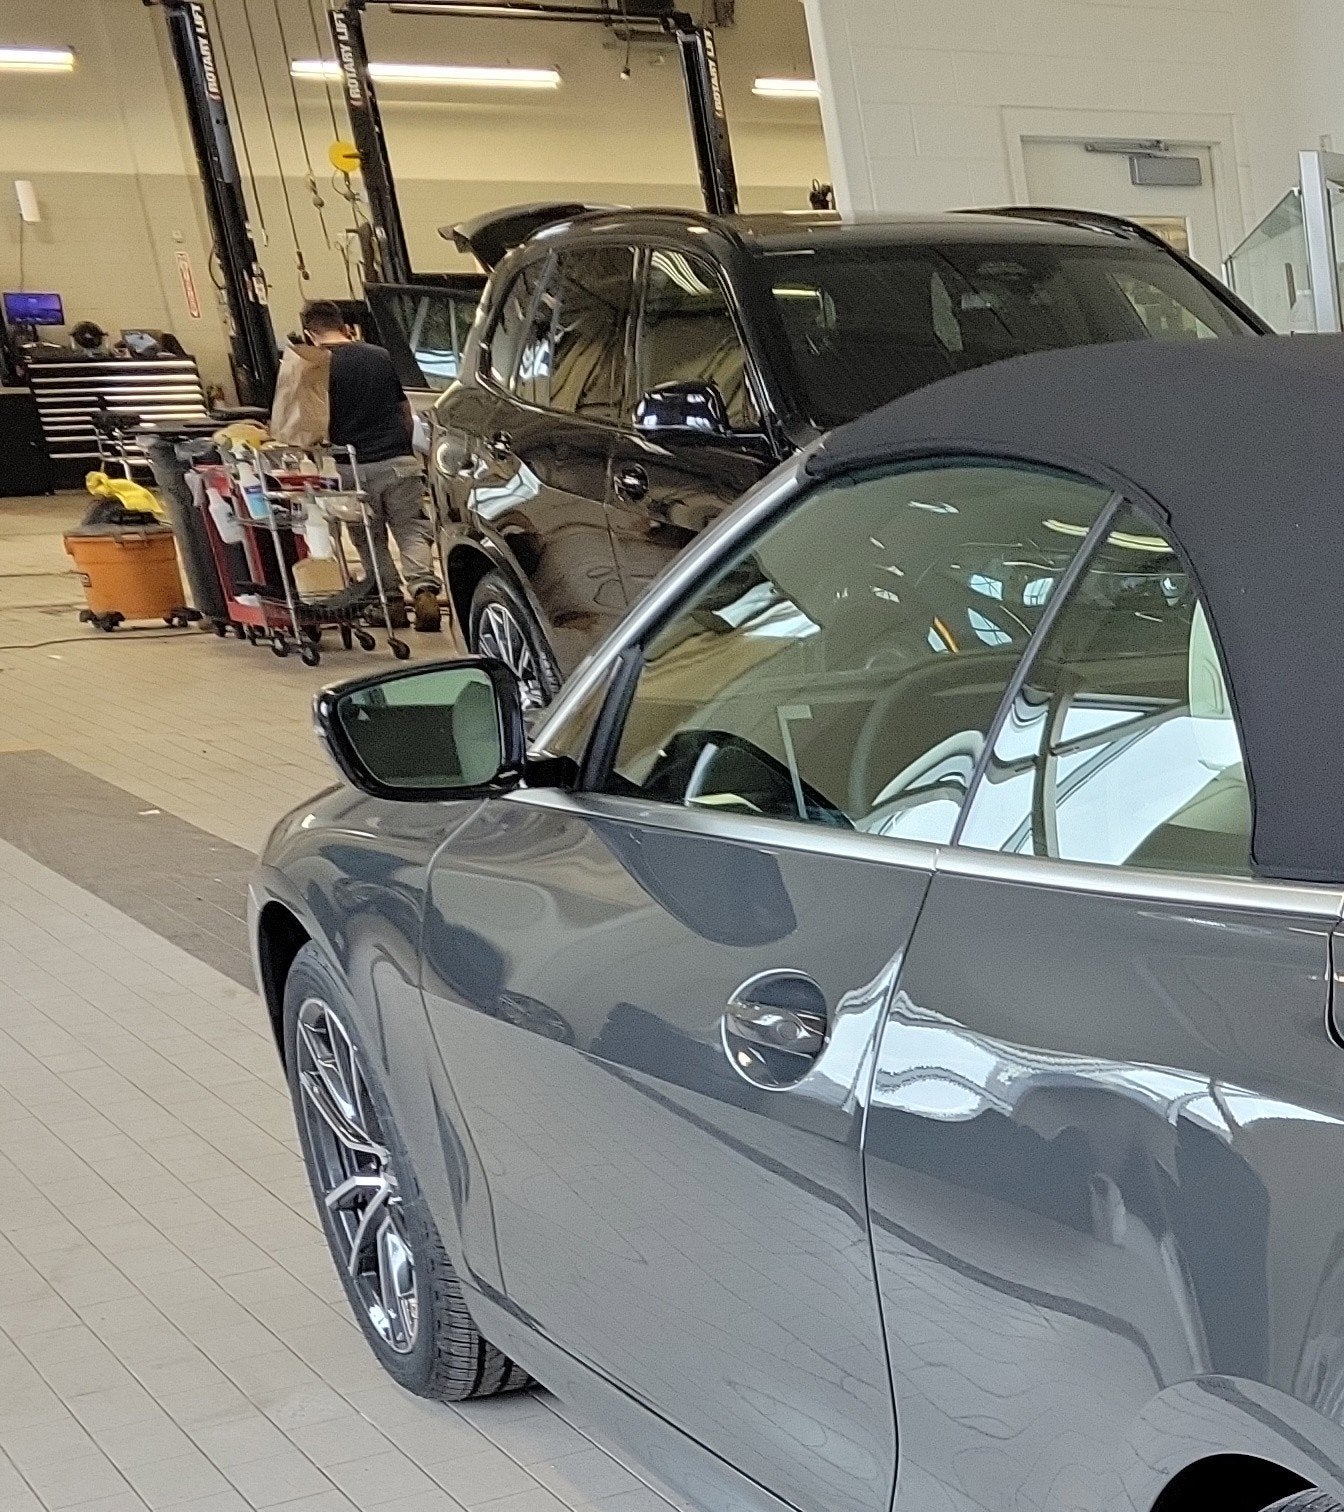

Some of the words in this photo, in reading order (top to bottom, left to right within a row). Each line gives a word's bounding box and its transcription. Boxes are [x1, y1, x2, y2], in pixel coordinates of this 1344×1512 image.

[190, 5, 207, 35] LIFT
[333, 12, 350, 40] LIFT
[198, 36, 220, 93] ROTARY
[340, 43, 363, 99] ROTARY
